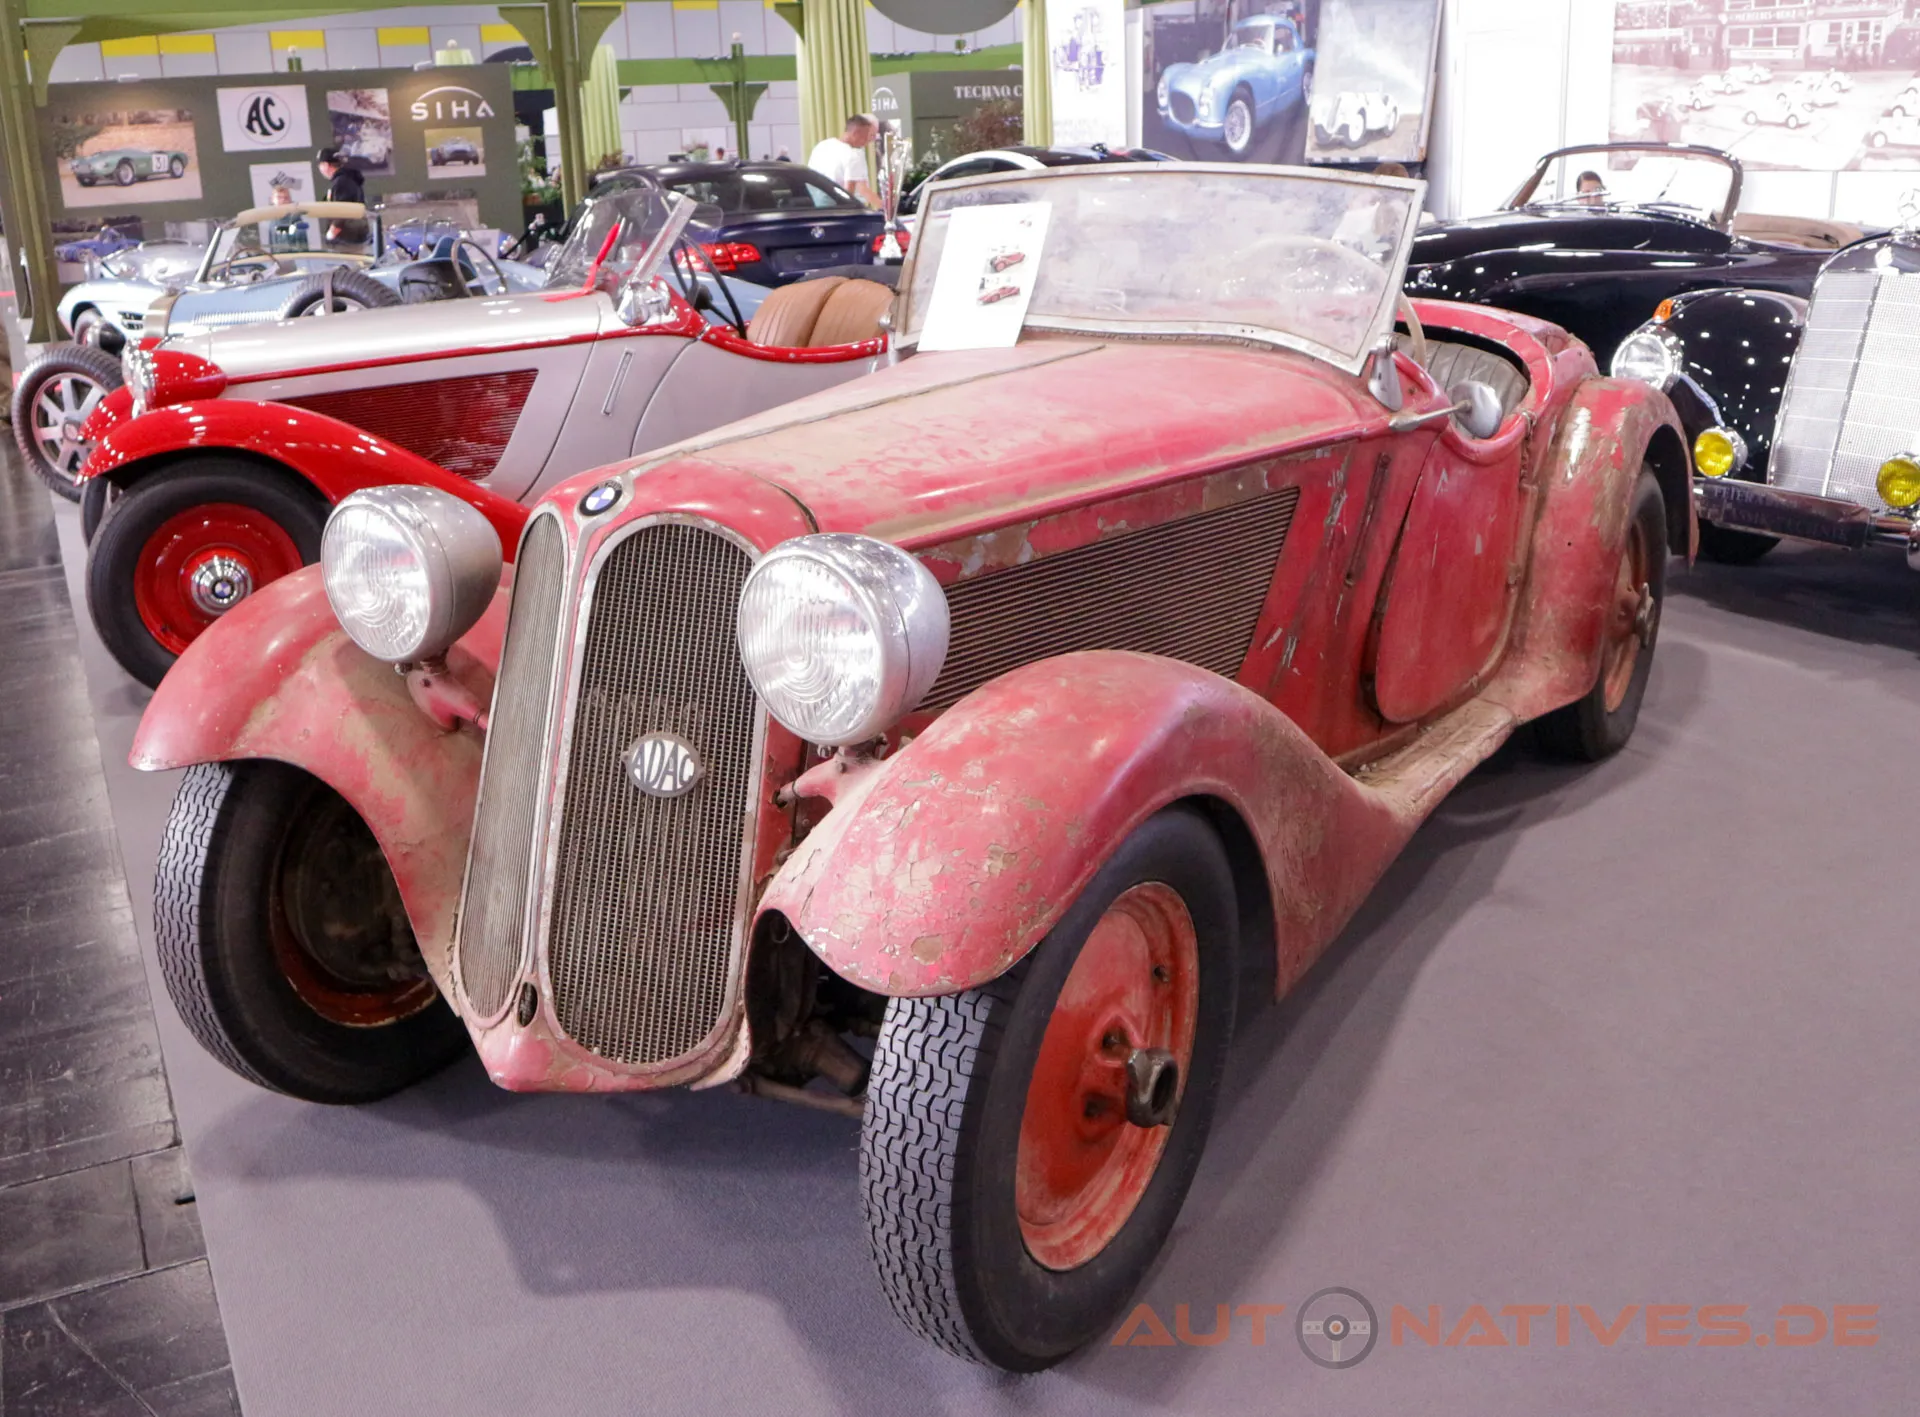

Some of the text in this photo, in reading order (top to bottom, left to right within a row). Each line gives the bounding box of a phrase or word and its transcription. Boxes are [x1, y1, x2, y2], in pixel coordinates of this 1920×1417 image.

[954, 85, 1011, 100] TECHNO
[246, 96, 285, 136] AC
[411, 100, 495, 121] SIHA
[630, 740, 696, 791] ADAC
